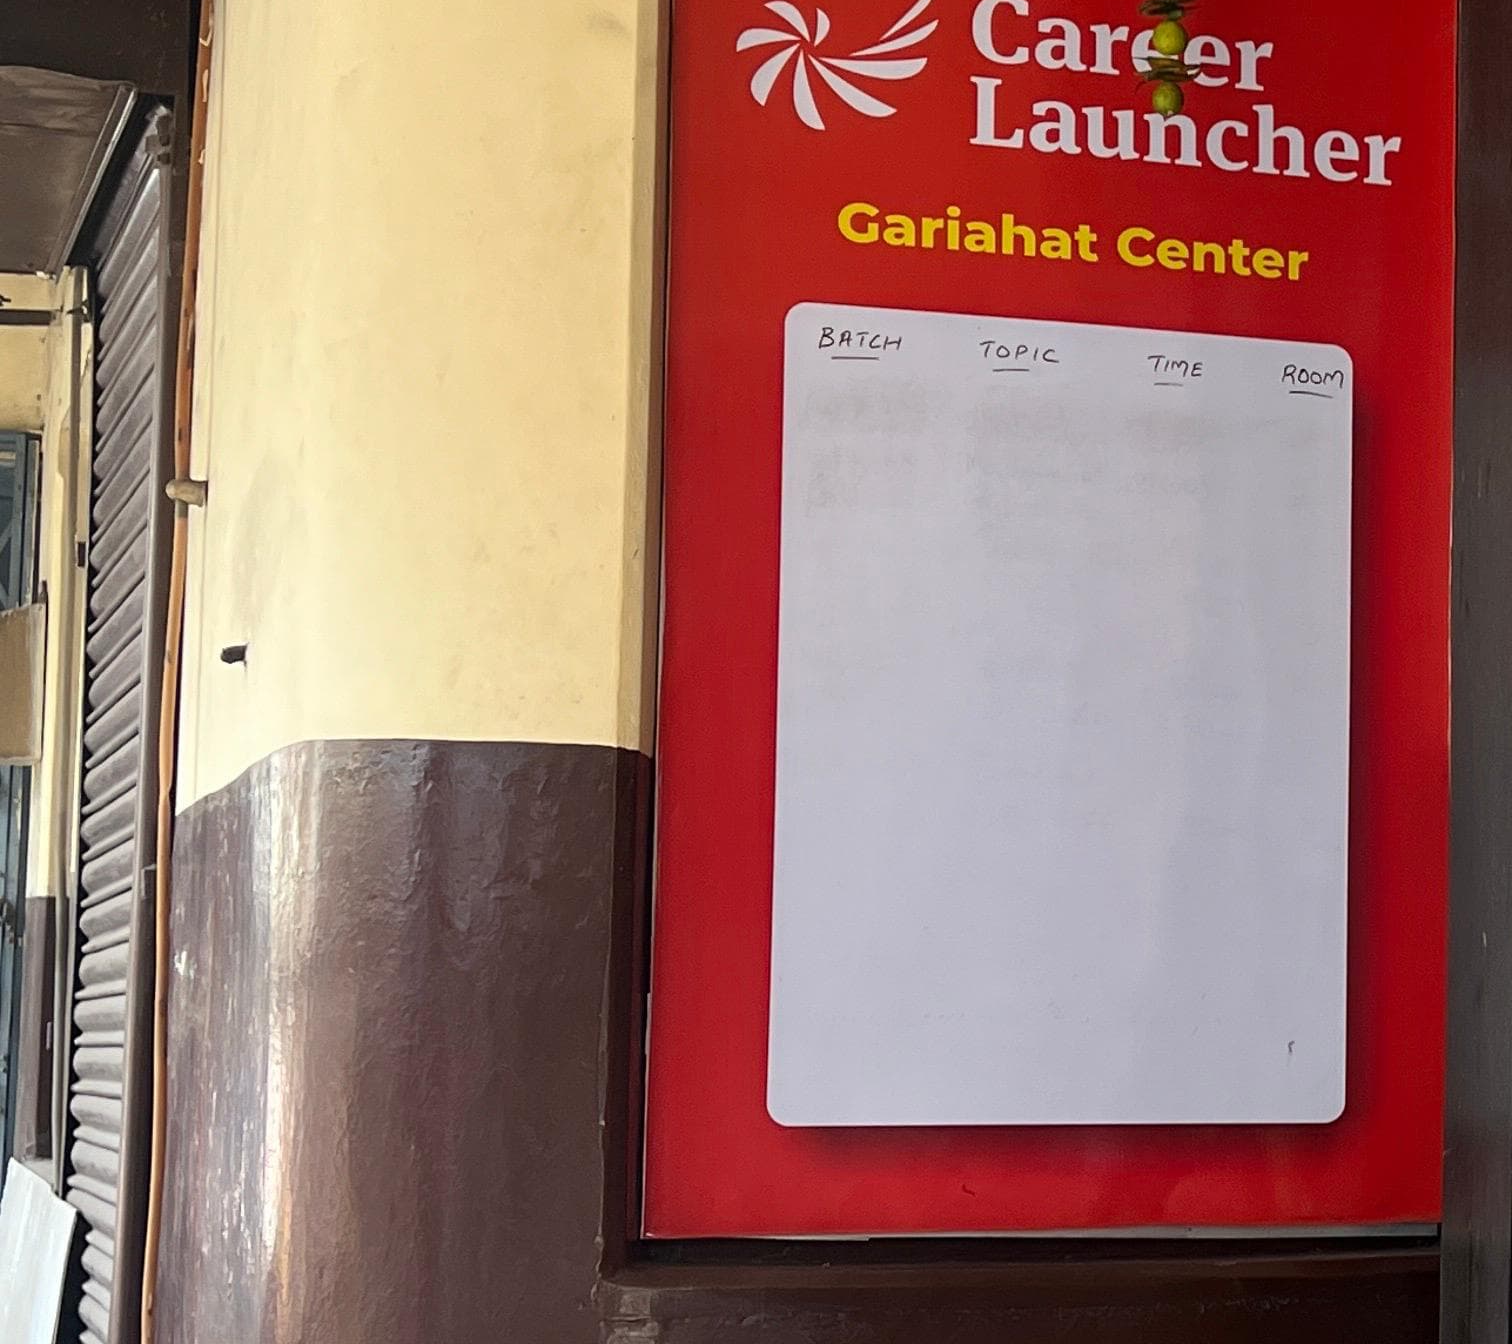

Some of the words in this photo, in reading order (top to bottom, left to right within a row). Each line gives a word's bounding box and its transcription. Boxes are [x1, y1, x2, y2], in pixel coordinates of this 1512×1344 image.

[969, 75, 1401, 187] Launcher
[837, 202, 1099, 262] Gariahat
[1116, 227, 1309, 280] Center
[818, 327, 902, 351] BATCH
[979, 340, 1060, 363] TOPIC
[1147, 355, 1203, 378] TIME
[1281, 364, 1345, 389] ROOM
